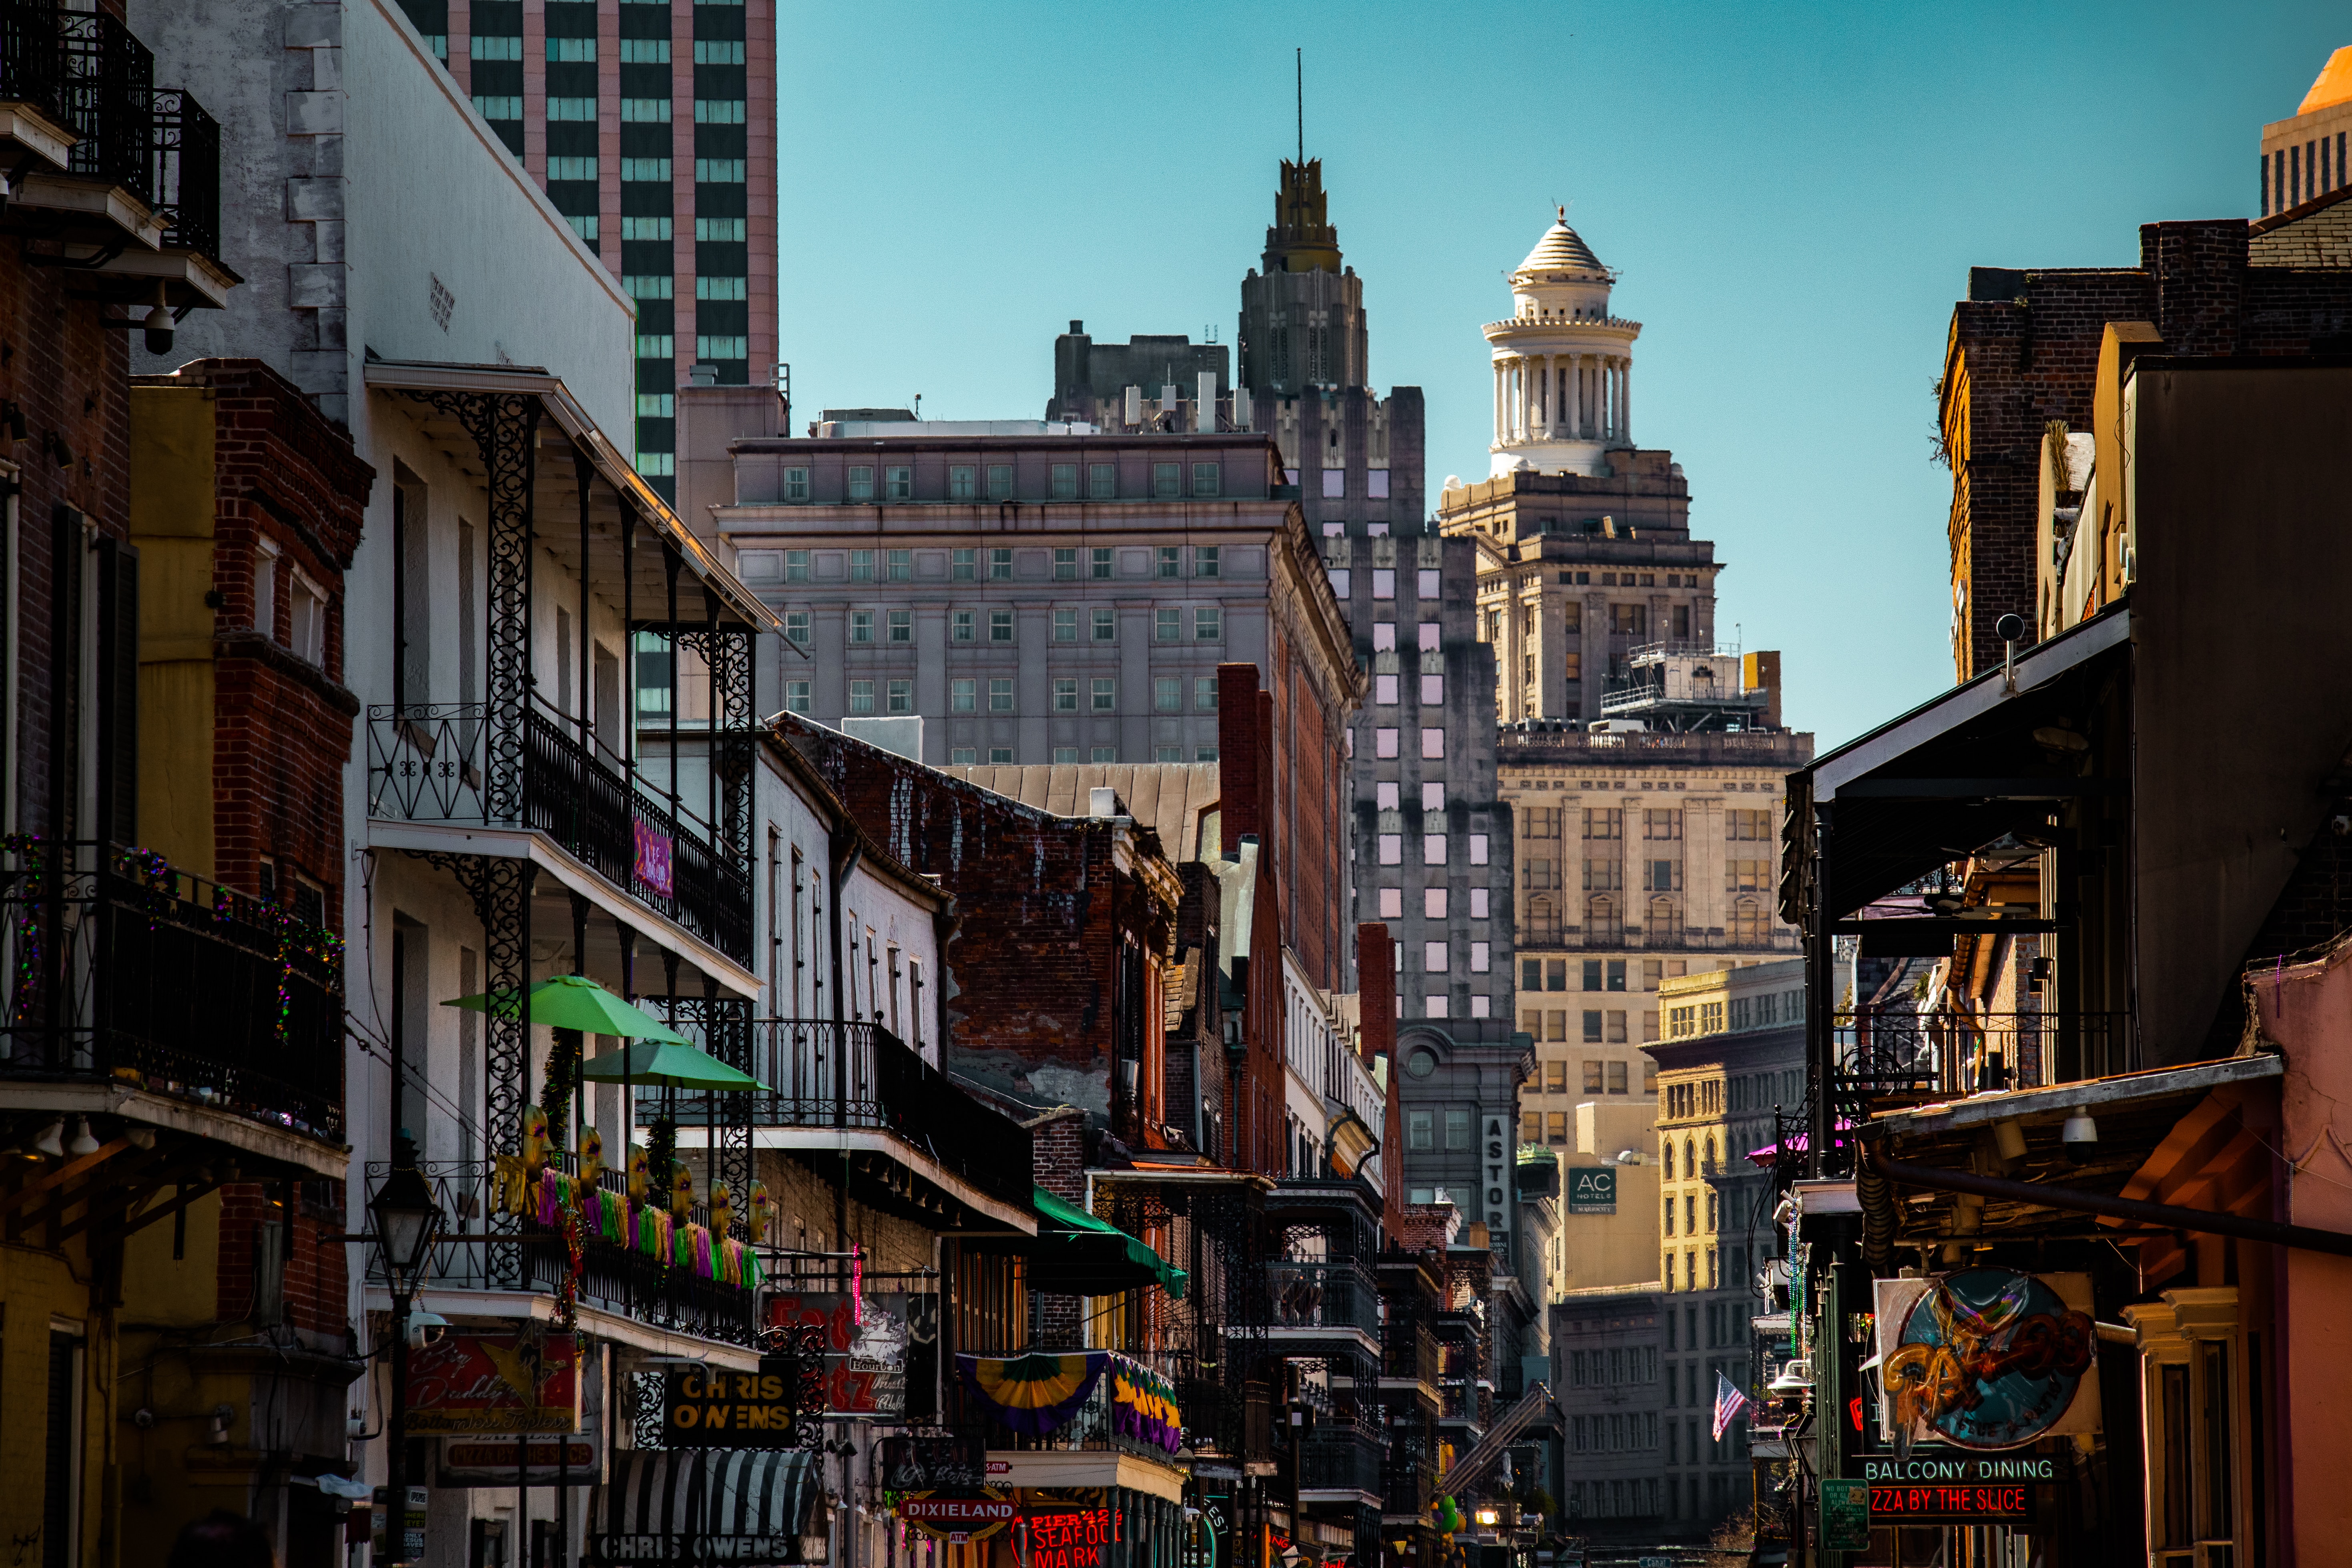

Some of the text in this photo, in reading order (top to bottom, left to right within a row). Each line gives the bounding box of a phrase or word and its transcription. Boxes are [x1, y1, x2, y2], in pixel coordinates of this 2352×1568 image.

[1489, 1120, 1503, 1228] ASTOR
[1577, 1174, 1611, 1192] AC
[411, 1340, 473, 1379] Big
[853, 1361, 900, 1371] Bourbon
[682, 1375, 783, 1400] CHRIS
[503, 1410, 571, 1432] Topless
[673, 1404, 791, 1430] OWENS
[454, 1446, 493, 1464] PIZZA
[497, 1446, 516, 1464] BY
[527, 1446, 545, 1463] HE
[1866, 1460, 2053, 1480] BALCONY DINING
[908, 1504, 1013, 1518] DIXIELAND
[1872, 1489, 2025, 1512] ZZA BY THE SLICE
[1031, 1514, 1081, 1529] PIER
[600, 1536, 788, 1560] CHRIS OWENS
[951, 1534, 968, 1542] ATM
